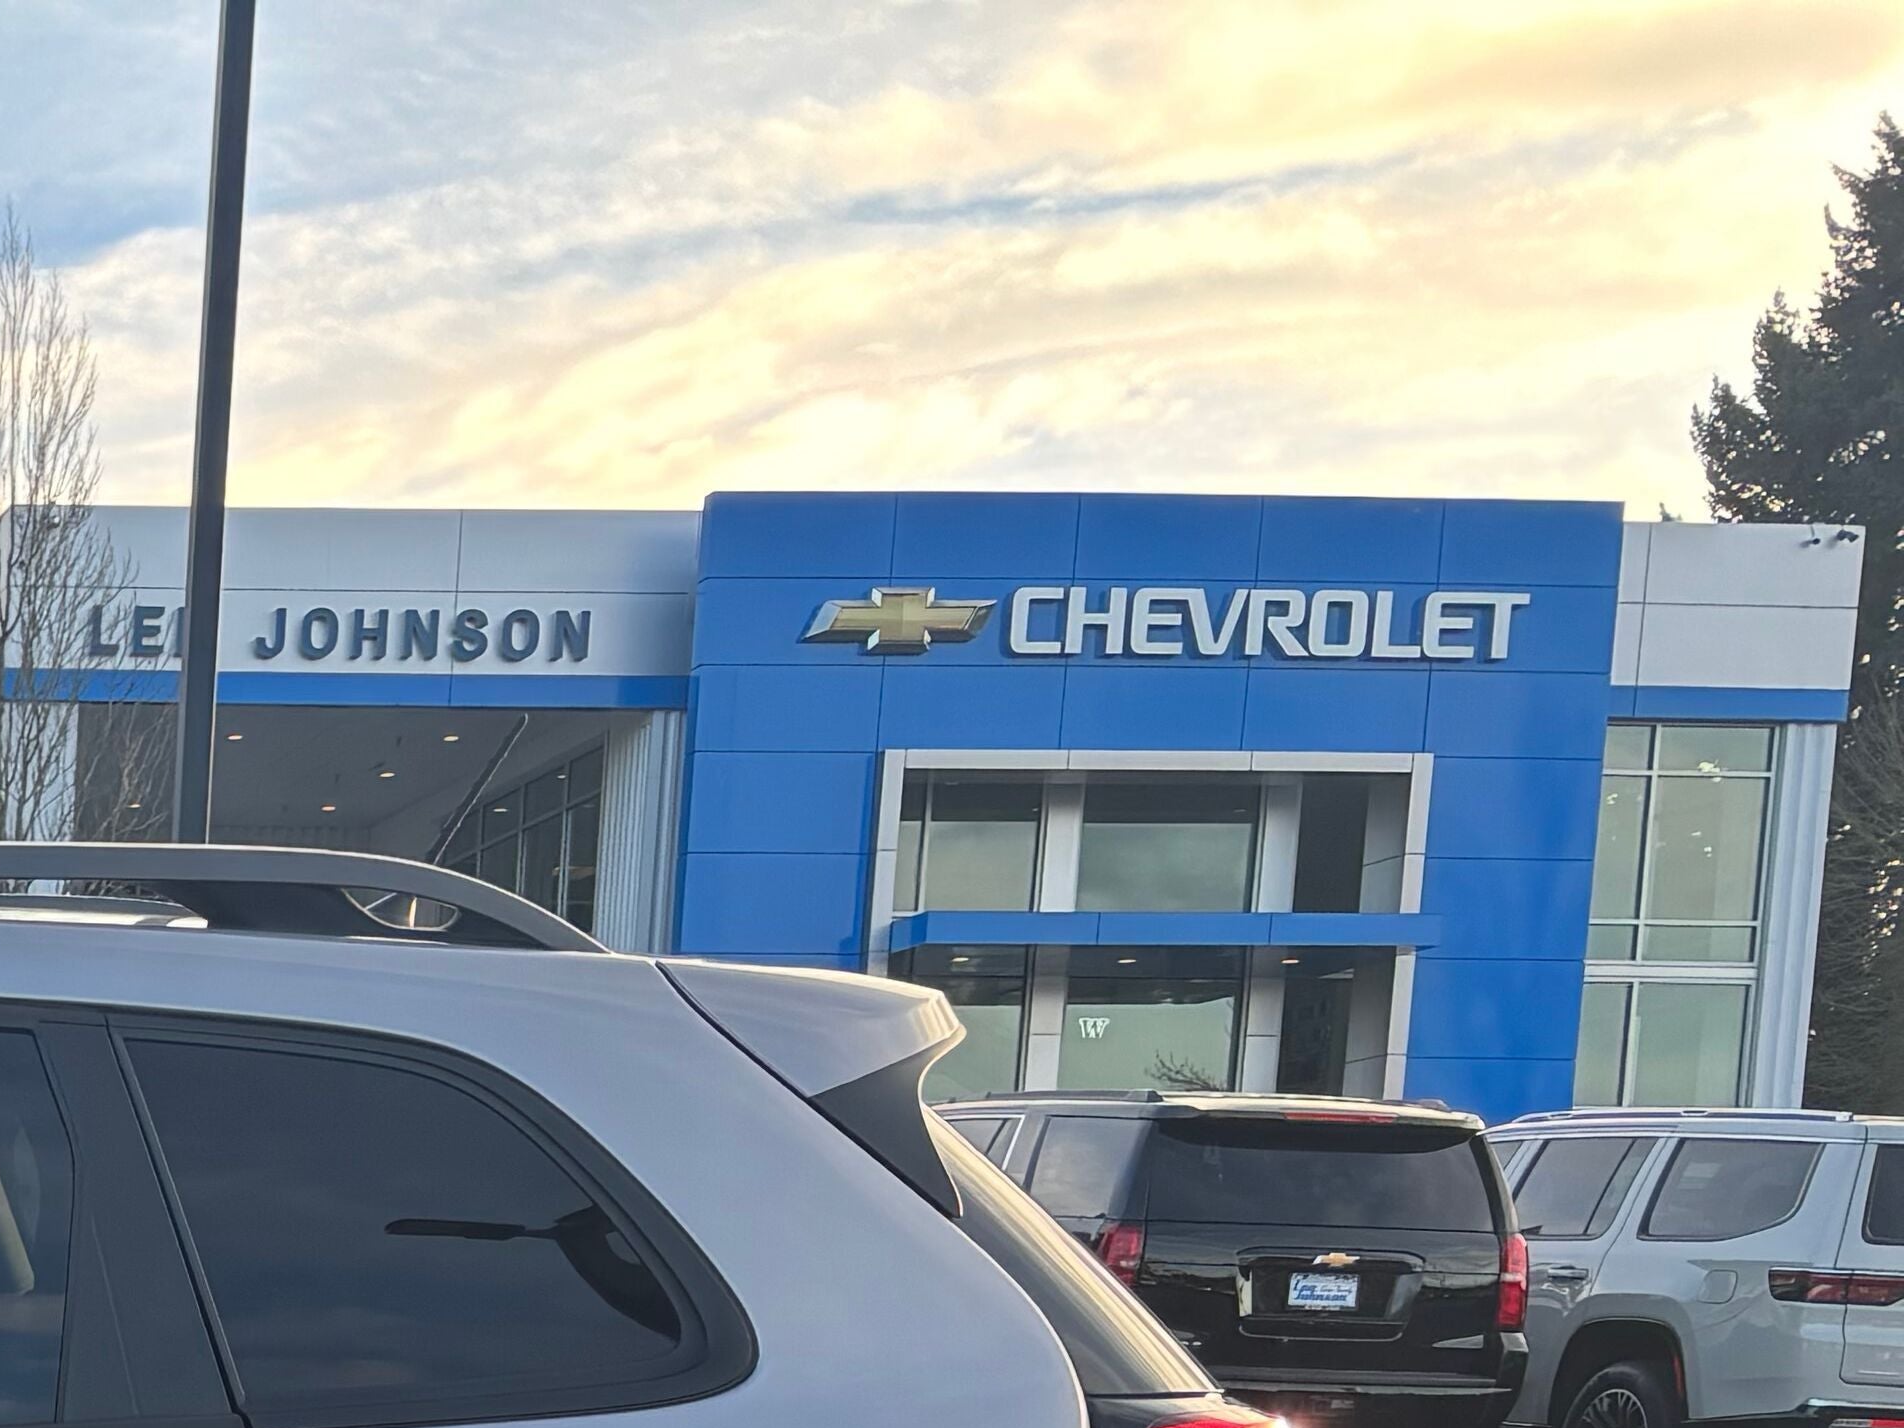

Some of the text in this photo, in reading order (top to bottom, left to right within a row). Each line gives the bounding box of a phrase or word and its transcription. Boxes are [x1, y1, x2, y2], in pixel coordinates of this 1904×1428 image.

[252, 606, 592, 662] JOHNSON
[1009, 586, 1531, 660] CHEVROLET
[1078, 1017, 1111, 1039] W
